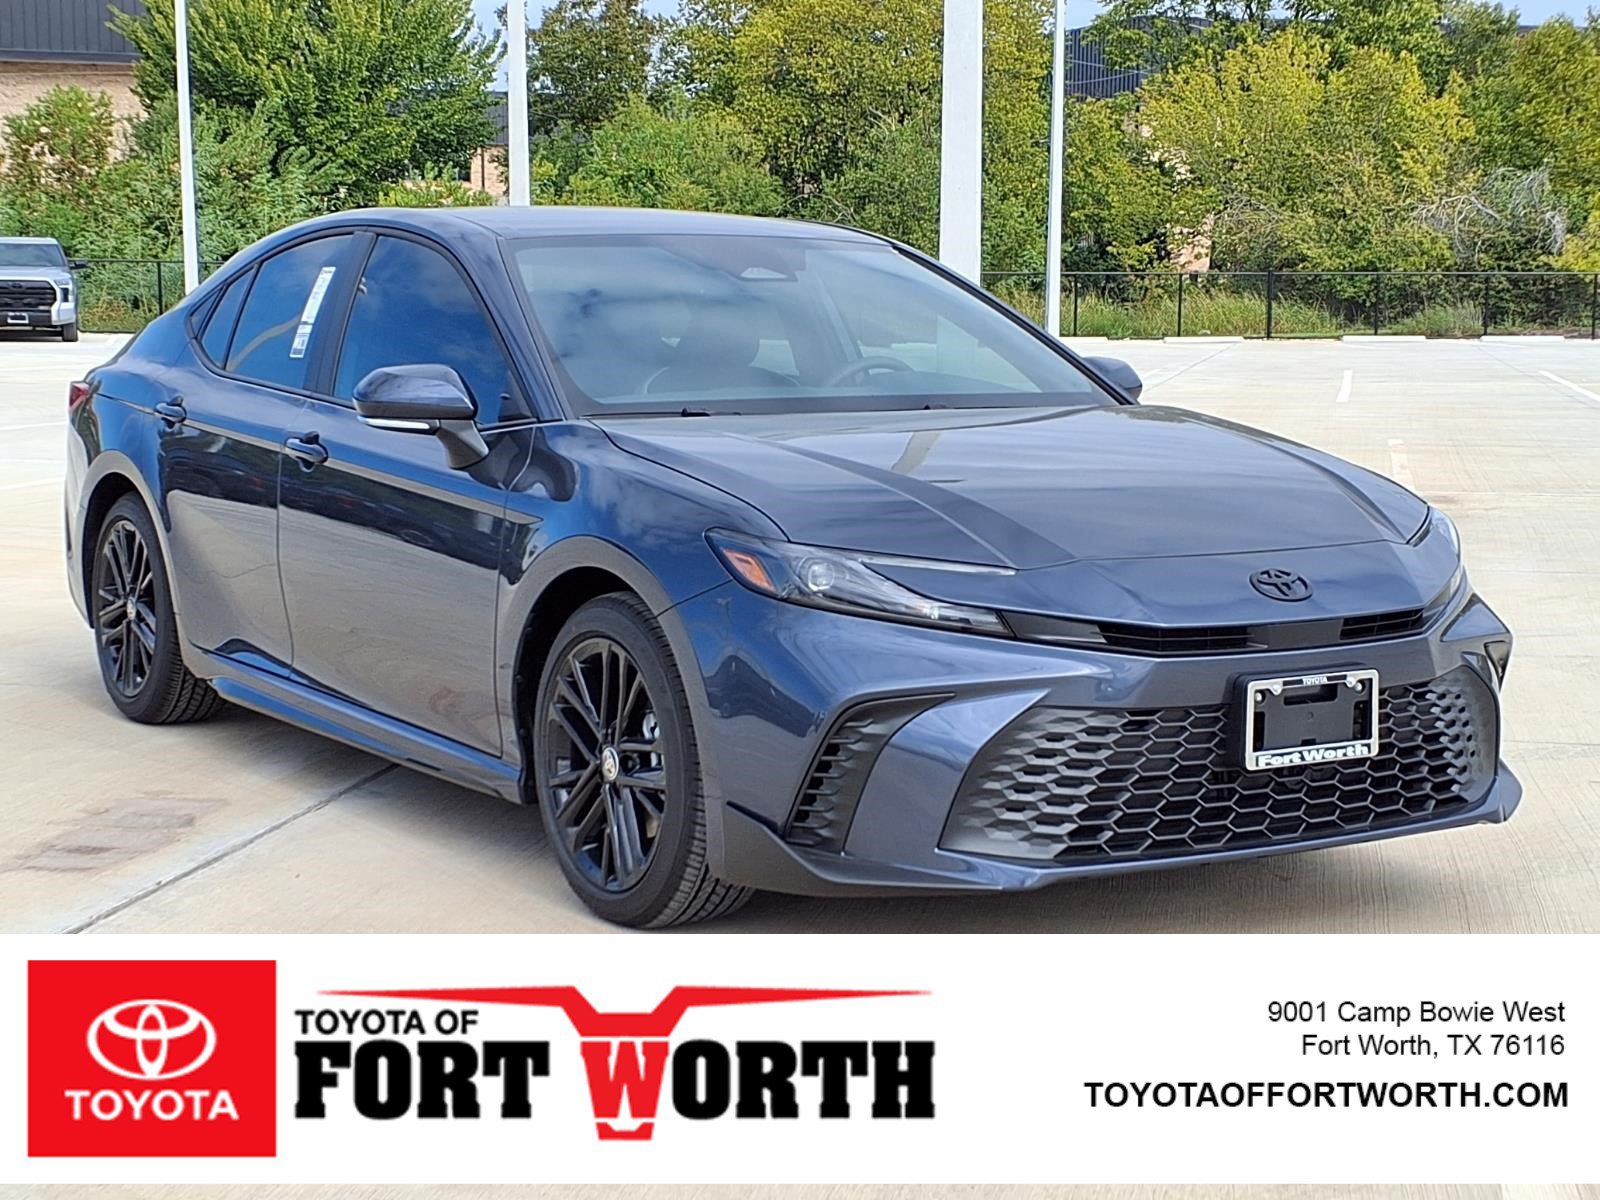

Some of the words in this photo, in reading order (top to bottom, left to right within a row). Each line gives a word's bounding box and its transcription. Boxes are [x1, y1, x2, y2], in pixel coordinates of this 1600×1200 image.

[1302, 676, 1328, 686] TOYOTA
[1258, 752, 1301, 767] Fort
[1303, 743, 1369, 761] Worth
